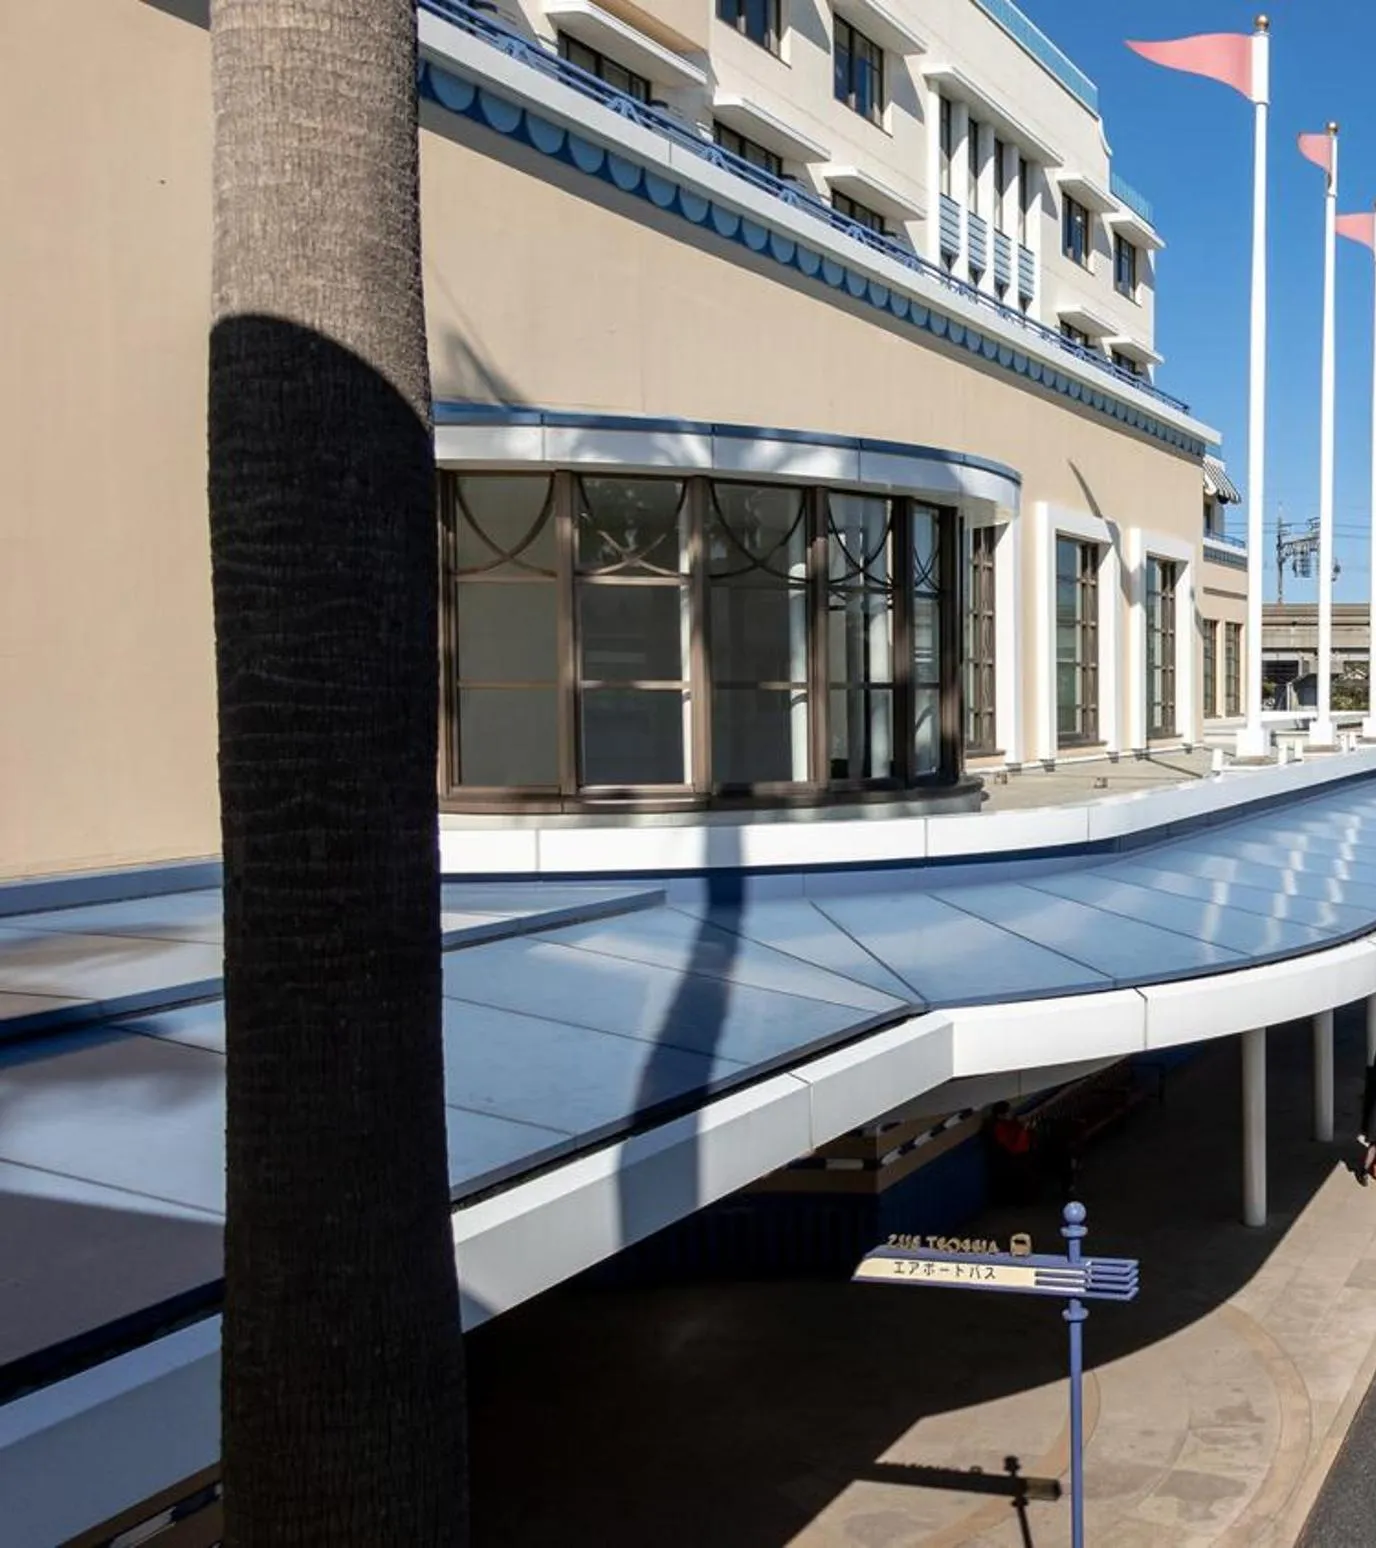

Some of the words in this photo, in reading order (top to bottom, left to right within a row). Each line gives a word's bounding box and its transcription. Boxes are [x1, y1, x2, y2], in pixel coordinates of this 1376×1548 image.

[893, 1260, 997, 1280] エアポートバス
